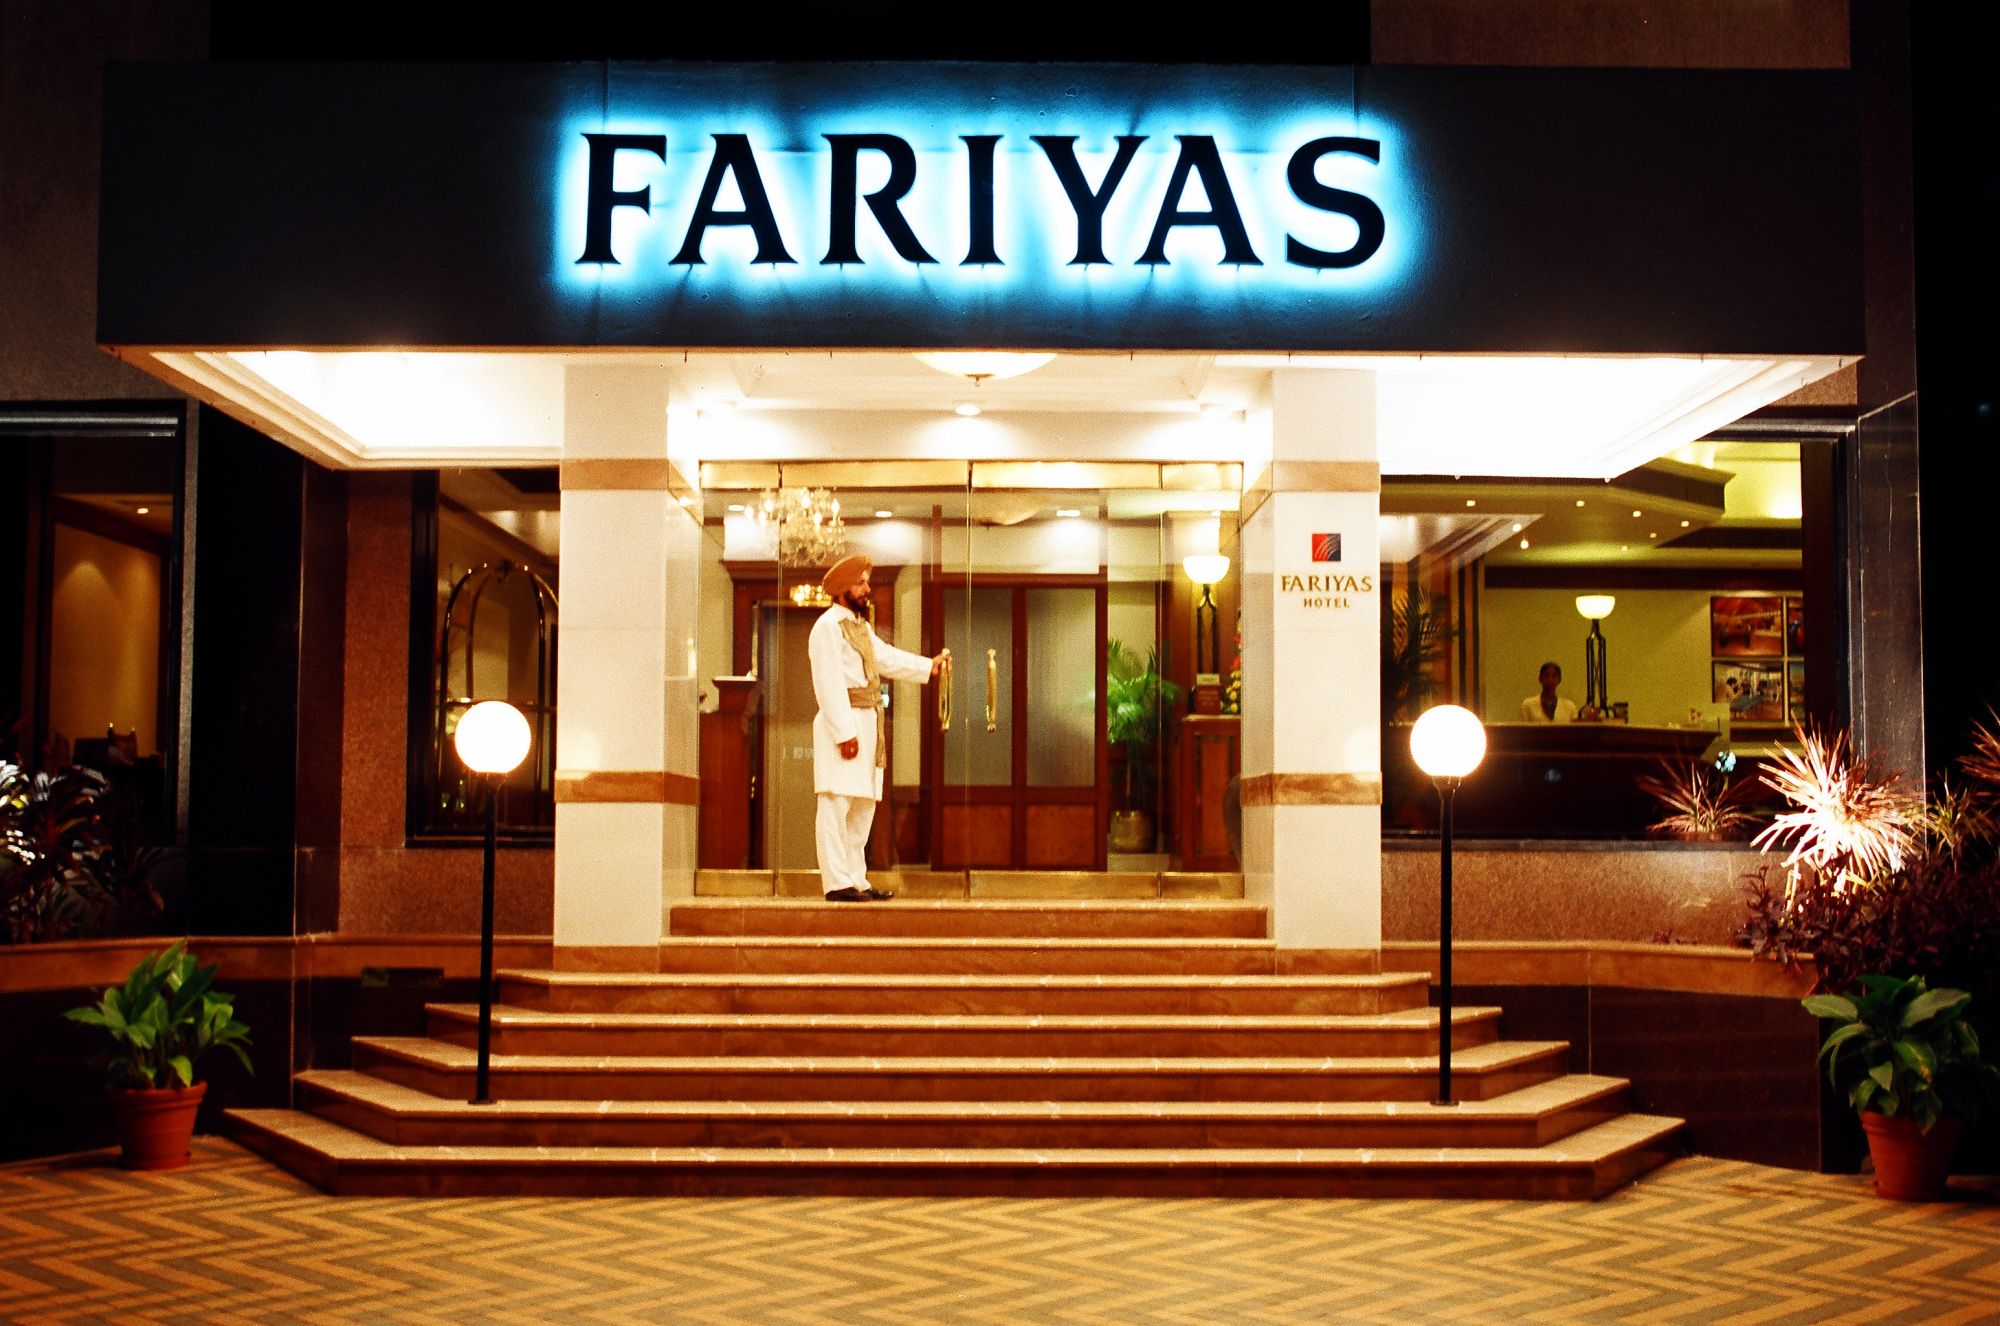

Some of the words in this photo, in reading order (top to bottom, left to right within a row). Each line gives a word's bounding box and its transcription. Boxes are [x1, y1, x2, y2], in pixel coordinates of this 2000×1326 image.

[575, 133, 1386, 269] FARIYAS
[1282, 575, 1372, 592] FARIYAS
[1303, 598, 1350, 608] HOTEL
